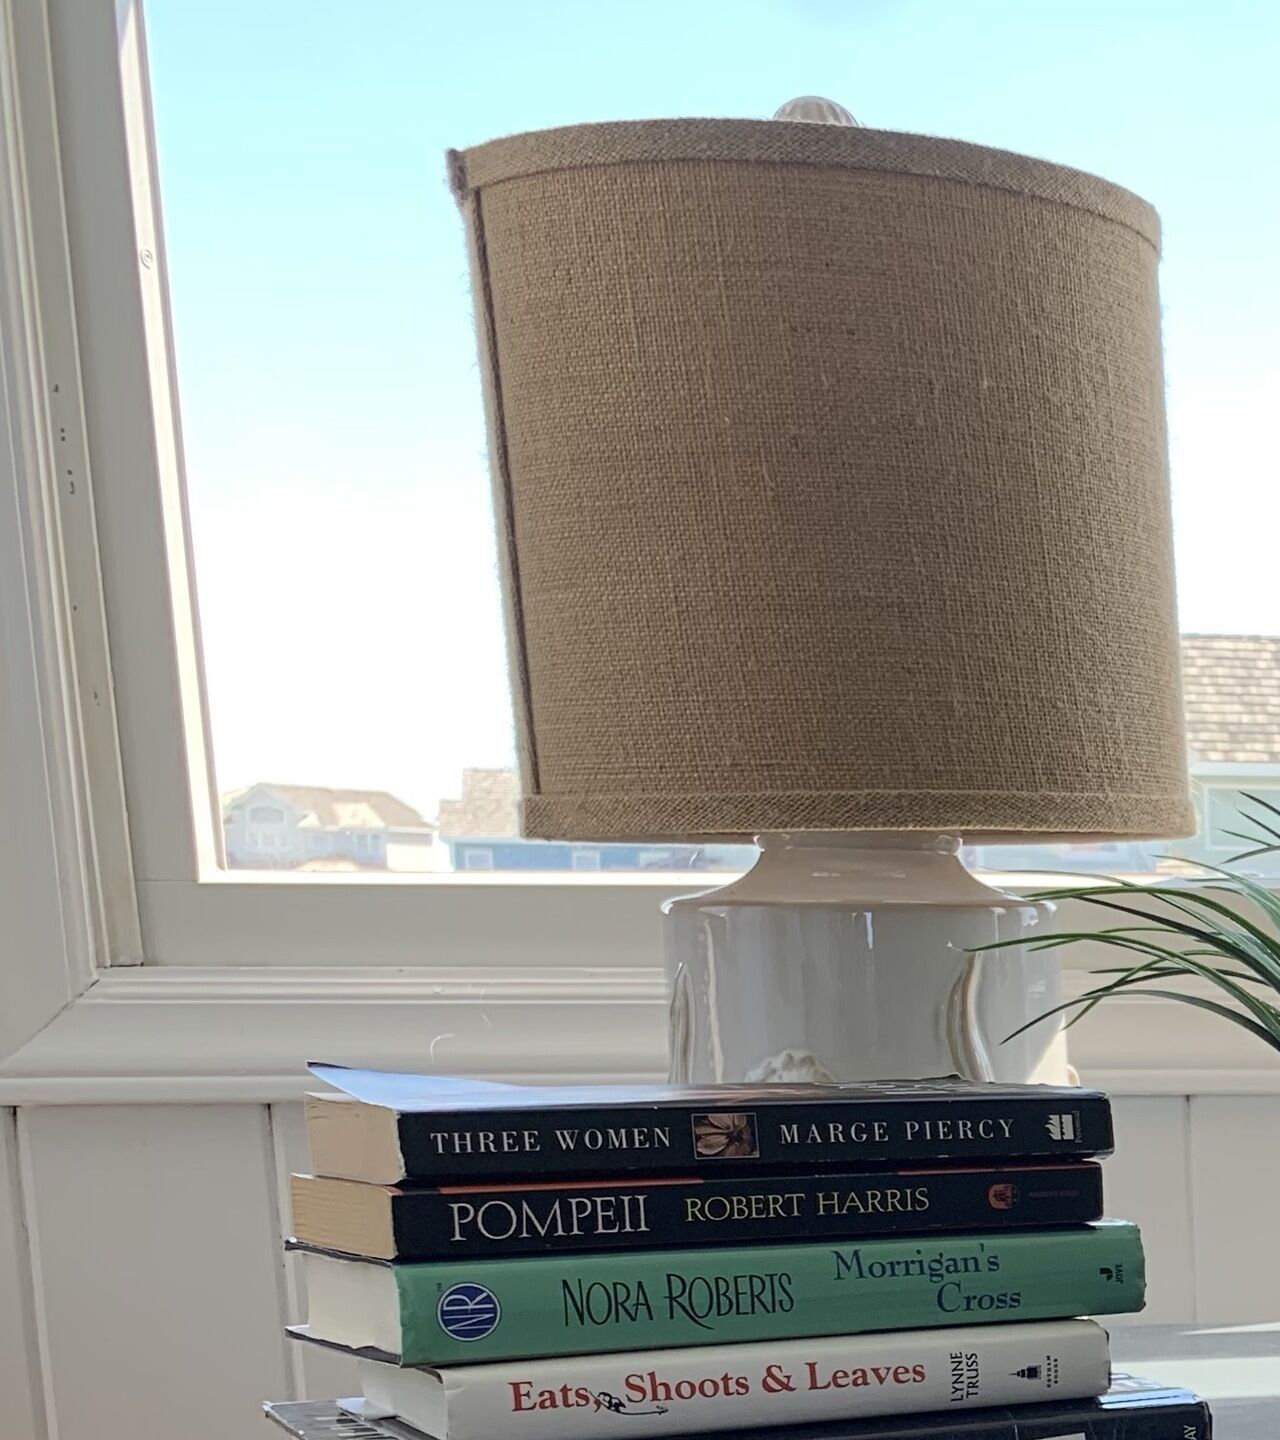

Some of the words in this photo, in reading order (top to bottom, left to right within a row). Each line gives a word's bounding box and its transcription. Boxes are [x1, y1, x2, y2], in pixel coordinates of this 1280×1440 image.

[430, 1131, 540, 1155] THREE
[555, 1126, 671, 1151] WOMEN
[779, 1121, 889, 1145] MARGE
[904, 1118, 1014, 1142] PIERCY
[449, 1195, 651, 1242] POMPEII
[685, 1193, 806, 1222] ROBERT
[816, 1187, 930, 1216] HARRIS
[830, 1243, 1001, 1283] Morrigan's
[561, 1278, 654, 1327] NORA
[663, 1272, 795, 1331] ROBERTS
[936, 1281, 1022, 1313] Cross
[624, 1370, 750, 1403] Shoots
[761, 1364, 797, 1393] &
[804, 1362, 926, 1391] Leaves
[950, 1351, 964, 1402] LYNNE
[965, 1352, 979, 1399] TRUSS
